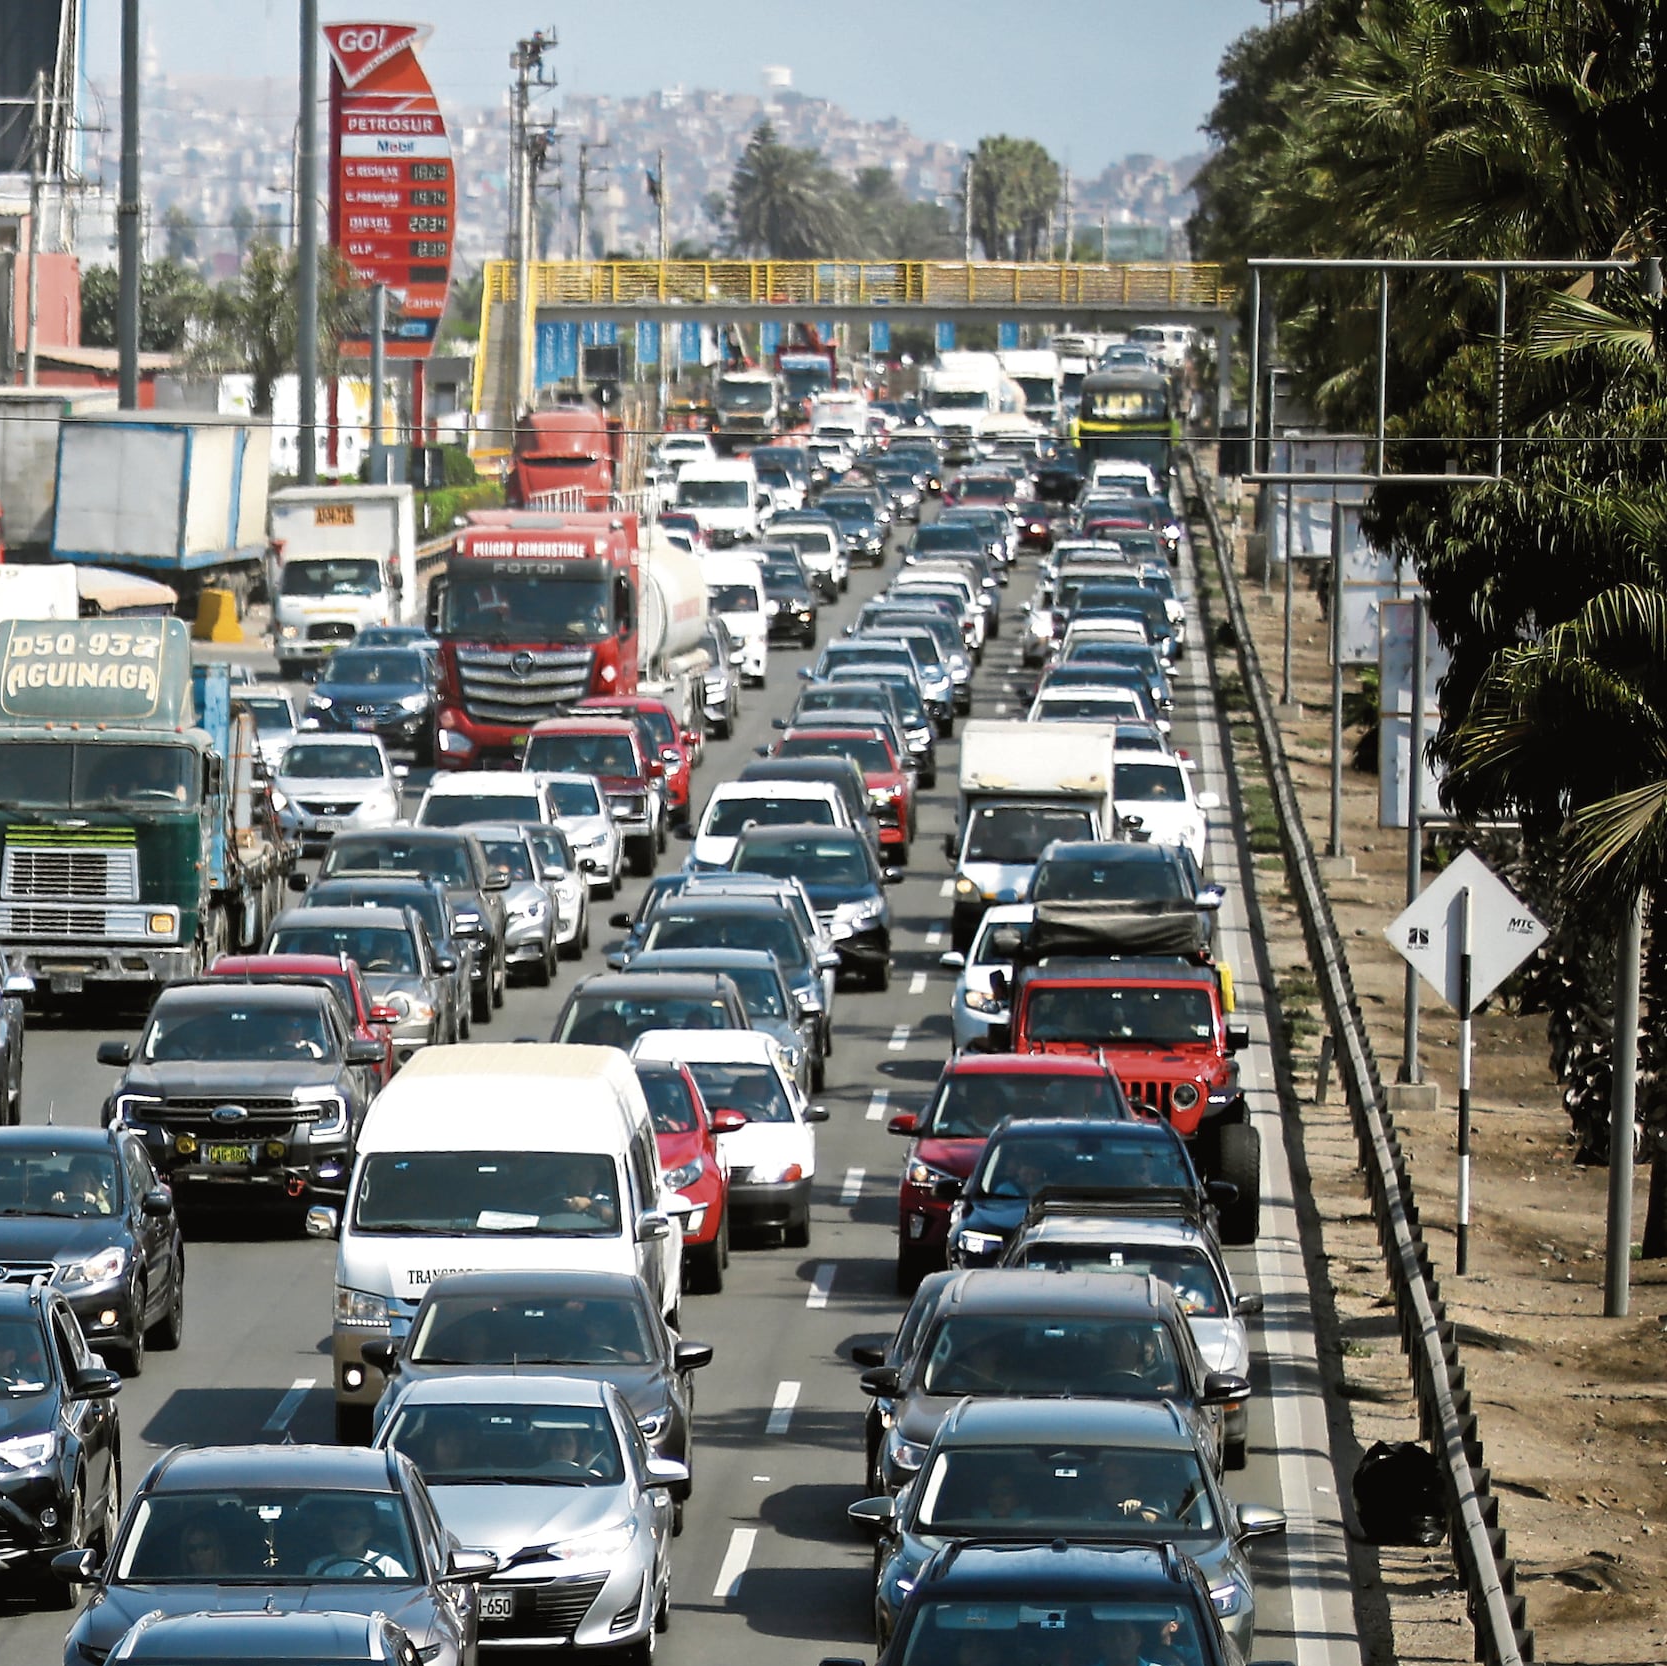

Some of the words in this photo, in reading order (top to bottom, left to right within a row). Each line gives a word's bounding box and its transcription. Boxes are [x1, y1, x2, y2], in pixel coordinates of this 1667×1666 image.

[338, 27, 387, 52] GO!
[348, 118, 433, 132] PETROSUR
[377, 140, 414, 153] Mobil
[349, 216, 391, 228] DIESEL
[473, 541, 513, 557] PELIGRO
[516, 542, 585, 558] COMBUSTIBLE
[493, 563, 565, 574] FOTON
[7, 662, 156, 700] AGUINAGA
[1509, 917, 1535, 929] MTC
